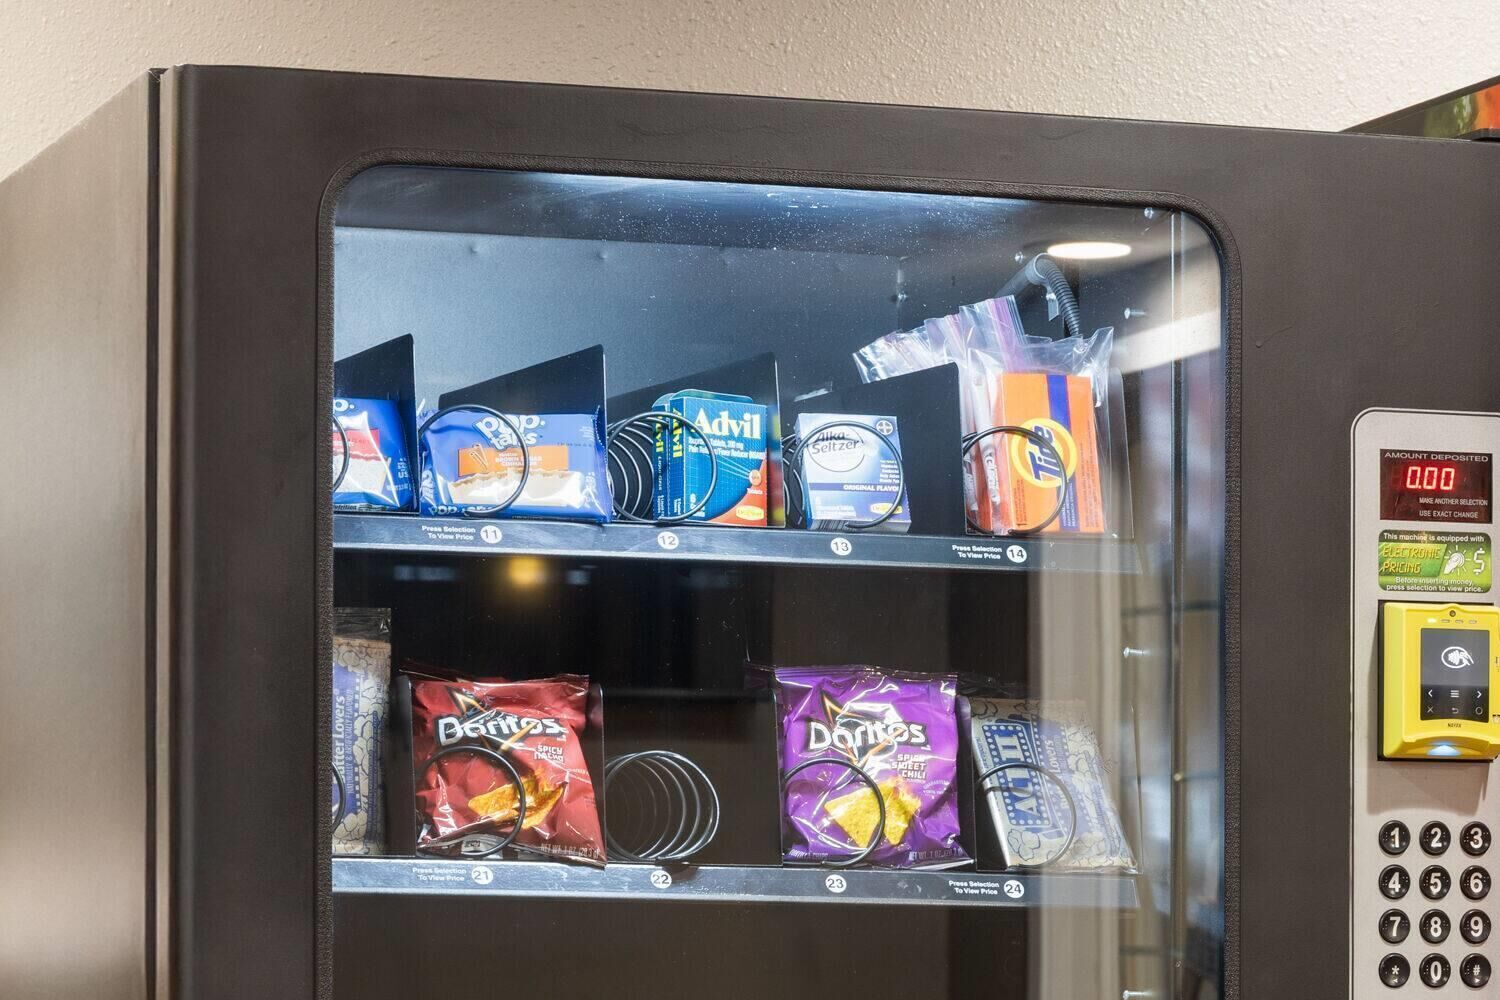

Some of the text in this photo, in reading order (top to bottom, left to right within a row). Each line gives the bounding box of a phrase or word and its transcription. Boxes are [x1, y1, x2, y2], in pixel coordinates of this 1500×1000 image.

[690, 407, 762, 439] Advil
[811, 440, 860, 455] Seltzer
[1431, 453, 1489, 462] DEPOSITED
[1406, 466, 1455, 490] 0.00
[1419, 497, 1434, 505] MAKE
[482, 528, 498, 540] 11
[658, 534, 677, 547] 12
[1383, 532, 1398, 540] This
[1436, 535, 1469, 543] equipped
[832, 540, 850, 553] 13
[1008, 548, 1025, 560] 14
[1382, 546, 1441, 560] ELECTRONIC
[1382, 561, 1421, 574] PRICING
[1419, 577, 1449, 586] inserting
[437, 711, 567, 746] Doritos
[807, 719, 927, 752] Doritos
[1390, 827, 1400, 848] 1
[1430, 827, 1442, 848] 2
[1470, 828, 1483, 849] 3
[473, 868, 490, 882] 21
[651, 873, 671, 886] 22
[1388, 871, 1401, 892] 4
[1429, 872, 1442, 893] 5
[1470, 872, 1483, 893] 6
[826, 877, 845, 890] 23
[1004, 883, 1022, 895] 24
[1389, 916, 1401, 937] 7
[1430, 916, 1442, 937] 8
[1470, 916, 1483, 937] 9
[1430, 961, 1442, 982] 0
